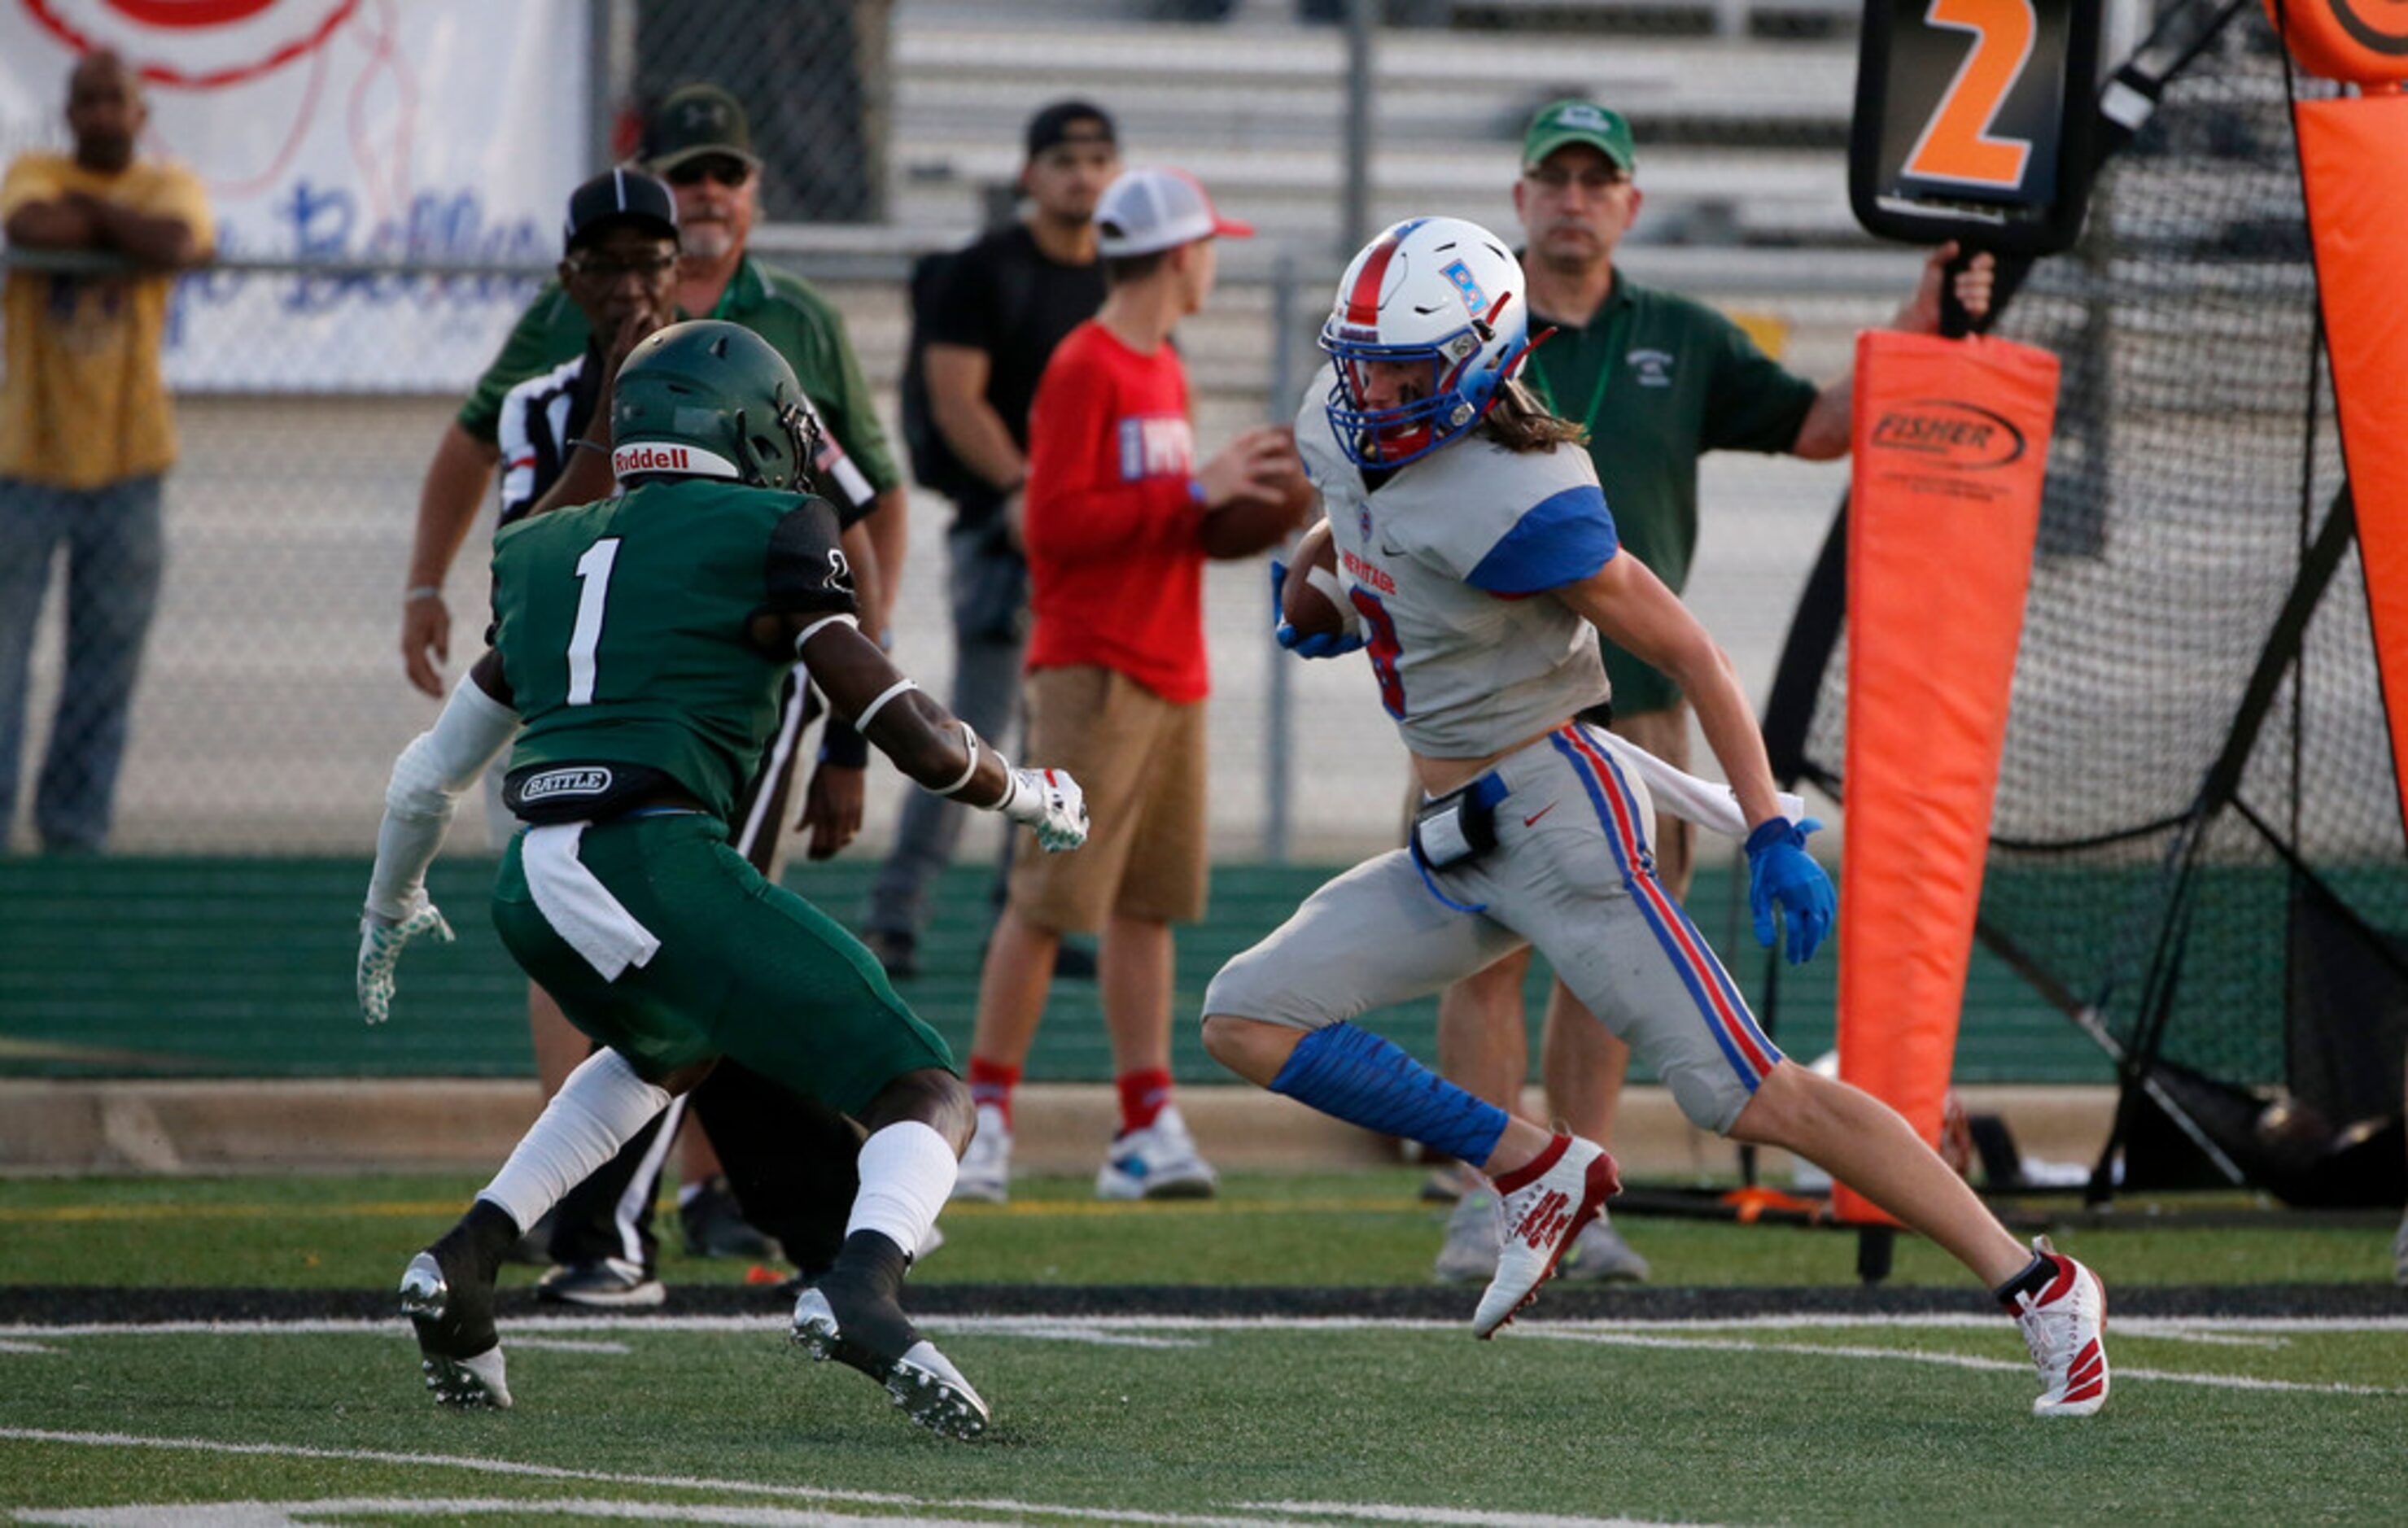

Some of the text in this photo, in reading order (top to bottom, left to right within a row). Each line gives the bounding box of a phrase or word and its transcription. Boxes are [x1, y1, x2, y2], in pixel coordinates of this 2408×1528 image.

[1900, 0, 2037, 190] 2
[1871, 413, 1995, 450] FISHER
[615, 448, 688, 472] Riddell
[567, 538, 621, 705] 1
[527, 773, 602, 795] BATTLE
